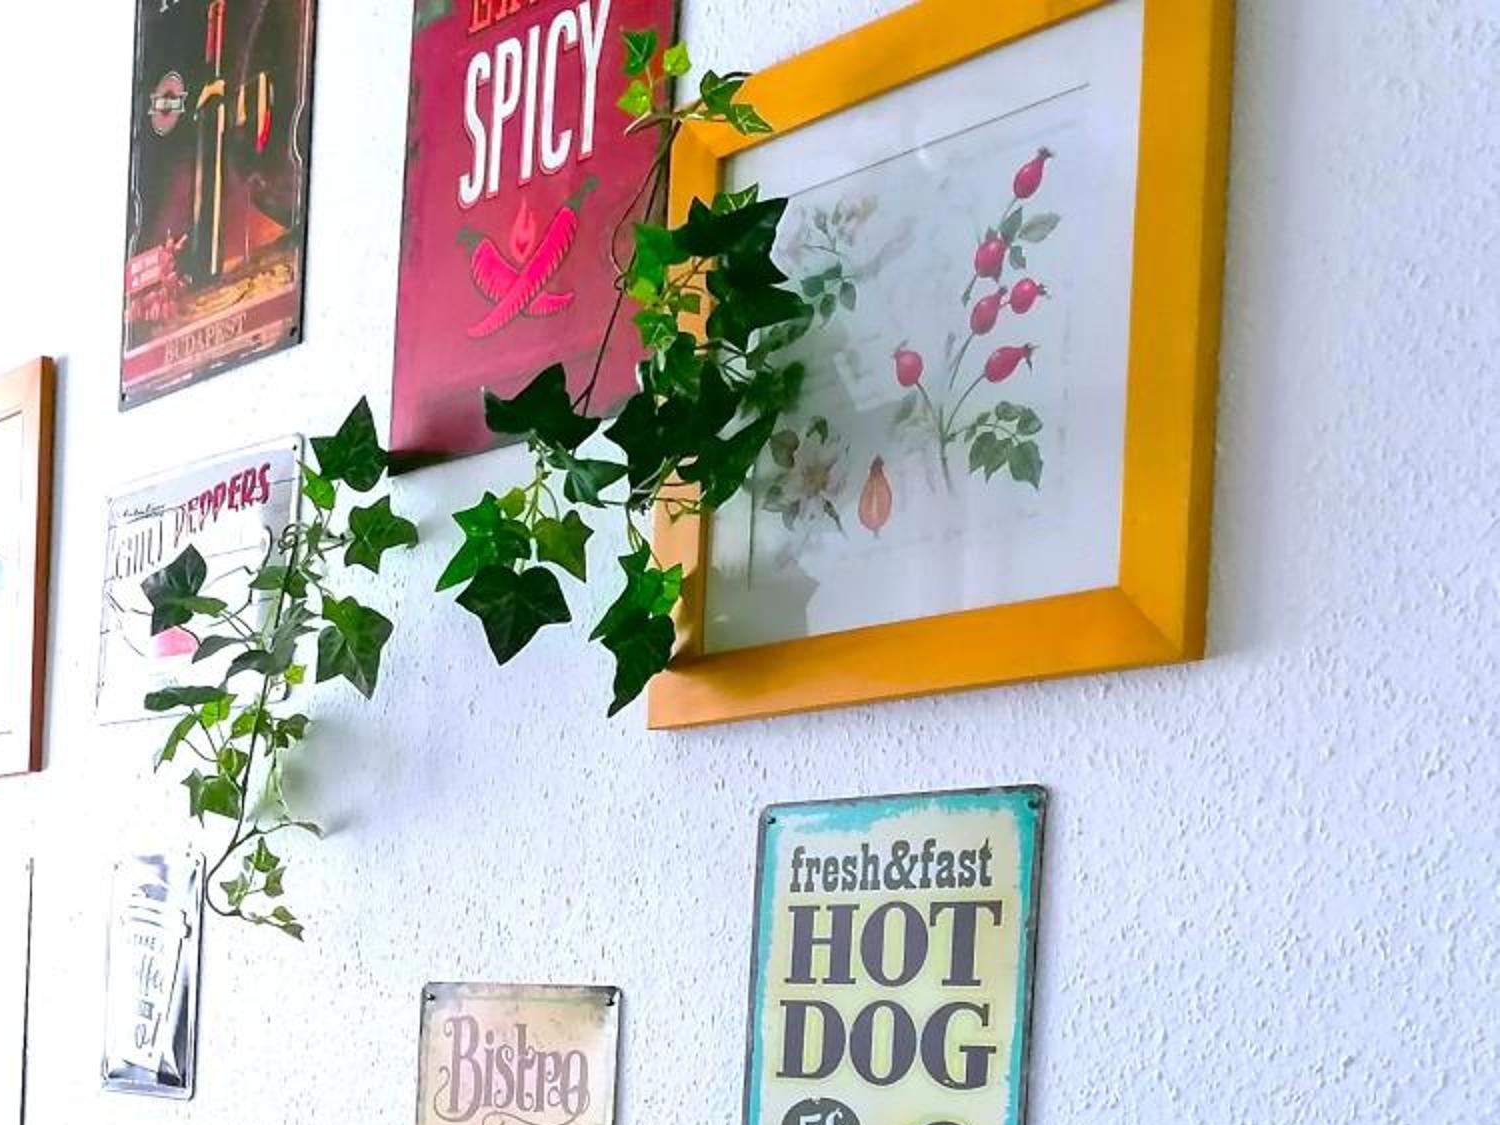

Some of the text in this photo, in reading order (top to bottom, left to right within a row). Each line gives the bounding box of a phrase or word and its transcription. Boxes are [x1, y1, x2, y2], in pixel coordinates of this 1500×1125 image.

[458, 0, 612, 207] SPICY
[165, 312, 247, 362] BUDAPEST
[788, 838, 993, 893] fresh&fast
[784, 899, 1002, 987] HOT
[776, 999, 997, 1090] DOG
